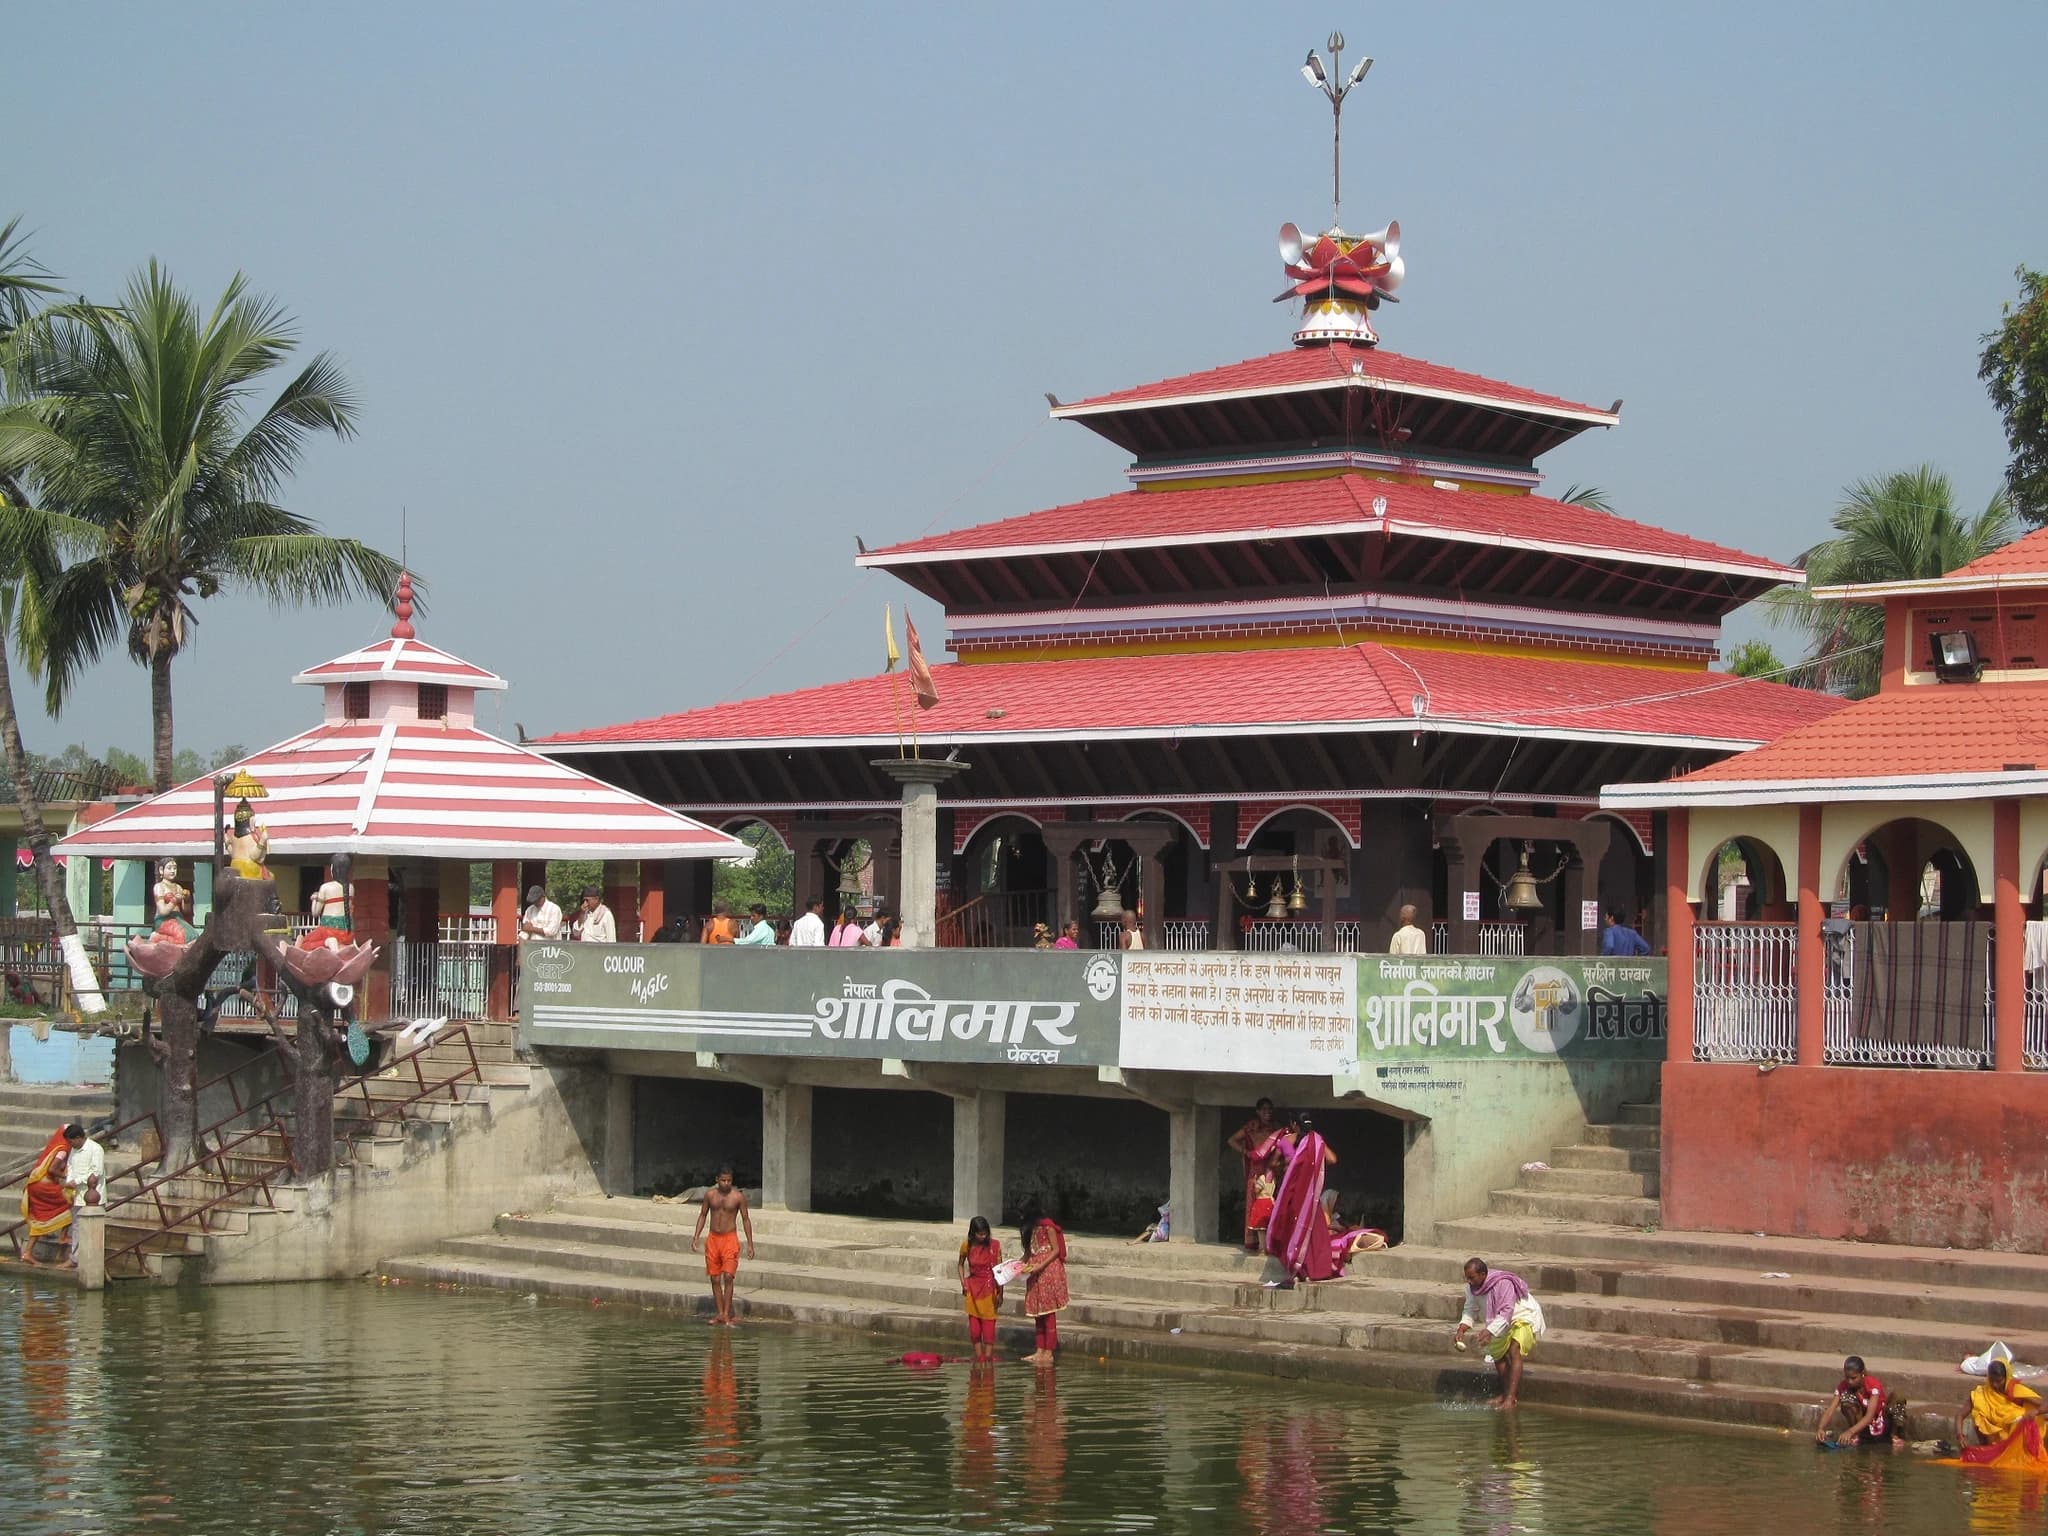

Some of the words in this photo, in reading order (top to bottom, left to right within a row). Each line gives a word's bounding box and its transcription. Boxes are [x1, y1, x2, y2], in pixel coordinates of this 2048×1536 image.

[541, 946, 561, 958] TUV
[603, 955, 645, 974] COLOUR
[1239, 959, 1253, 978] कि
[1255, 964, 1271, 982] इस
[1315, 966, 1342, 986] साबुन
[1379, 960, 1416, 979] निर्माण
[1464, 966, 1496, 983] आधार
[1582, 962, 1616, 986] सुरक्षित
[630, 972, 669, 1005] MAGIC
[842, 976, 877, 999] नेपाल
[1127, 983, 1147, 998] लगा
[1148, 979, 1158, 998] के
[1225, 987, 1240, 1005] इस
[1278, 983, 1288, 1004] के
[814, 979, 1081, 1046] शालिमार
[1148, 1001, 1162, 1021] को
[1164, 1003, 1188, 1024] गाली
[1231, 1006, 1241, 1027] के
[1244, 1012, 1264, 1028] साथ
[1366, 980, 1507, 1053] शालिमार
[1584, 984, 1668, 1040] सिमे
